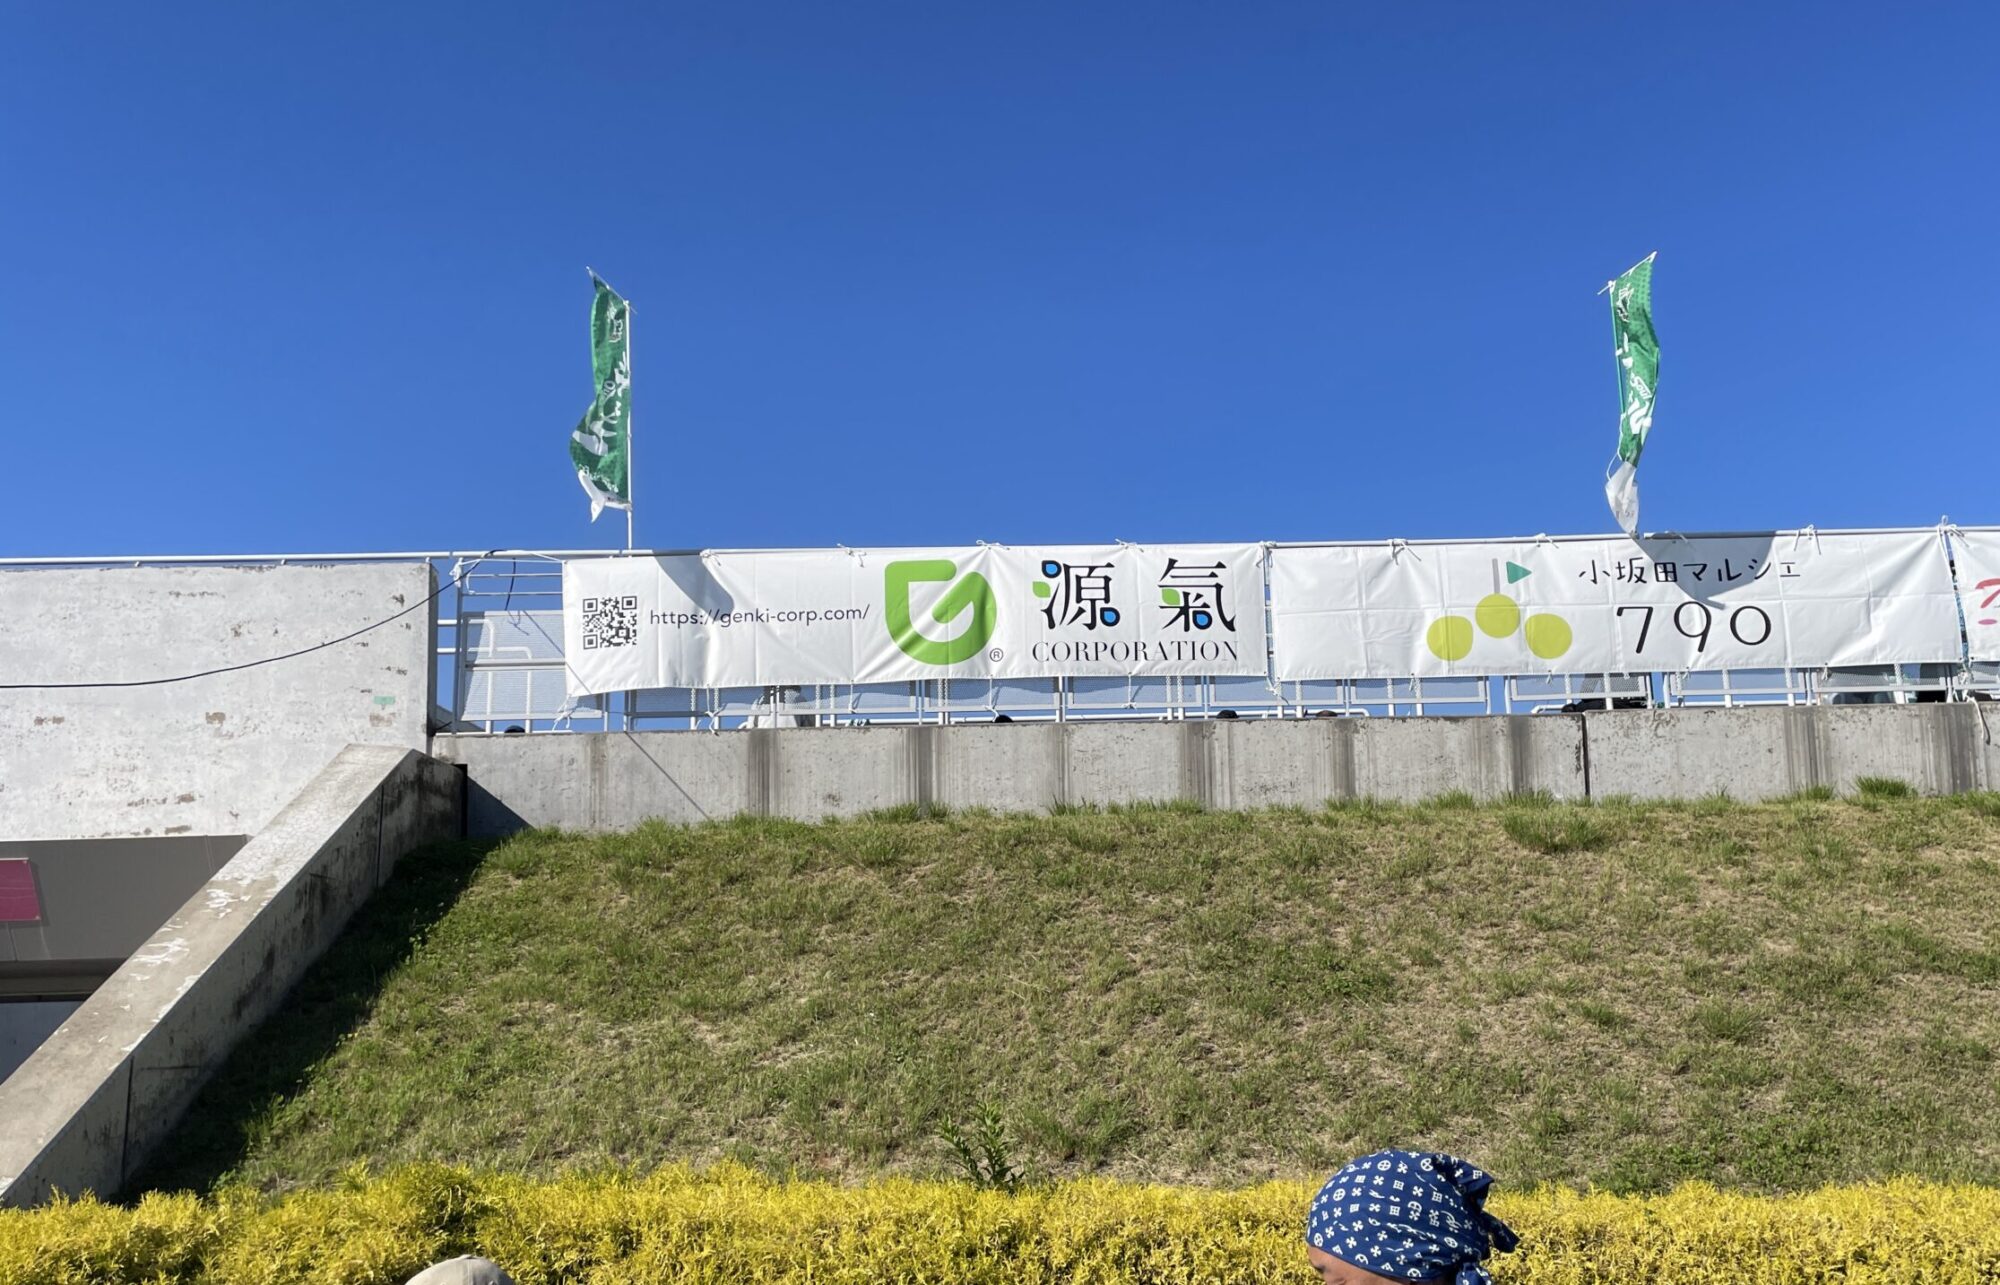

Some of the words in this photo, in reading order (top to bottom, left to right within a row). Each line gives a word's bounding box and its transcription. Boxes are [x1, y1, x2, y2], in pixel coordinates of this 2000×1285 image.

[650, 603, 871, 628] https://genki-corp.com/
[1616, 601, 1772, 654] 790
[1032, 640, 1239, 663] CORPORATION
